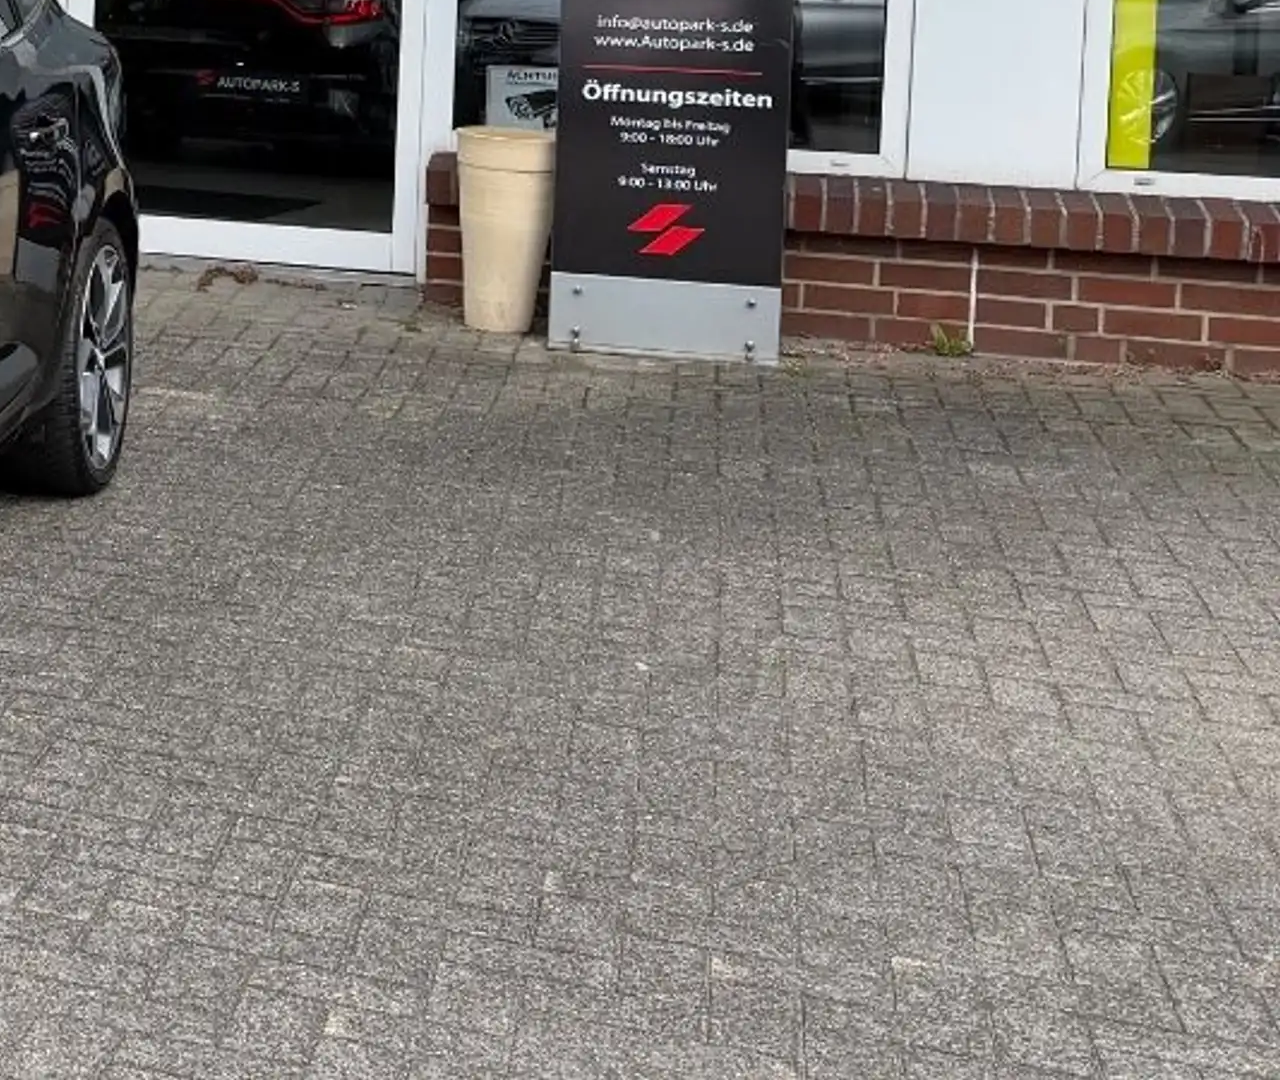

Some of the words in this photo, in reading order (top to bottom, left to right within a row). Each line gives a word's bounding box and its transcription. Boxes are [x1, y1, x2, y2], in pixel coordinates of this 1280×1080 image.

[593, 35, 755, 53] www.Autopark-s.de
[217, 75, 301, 93] AUTOPARK-S
[582, 80, 773, 109] Öffnungszeiten
